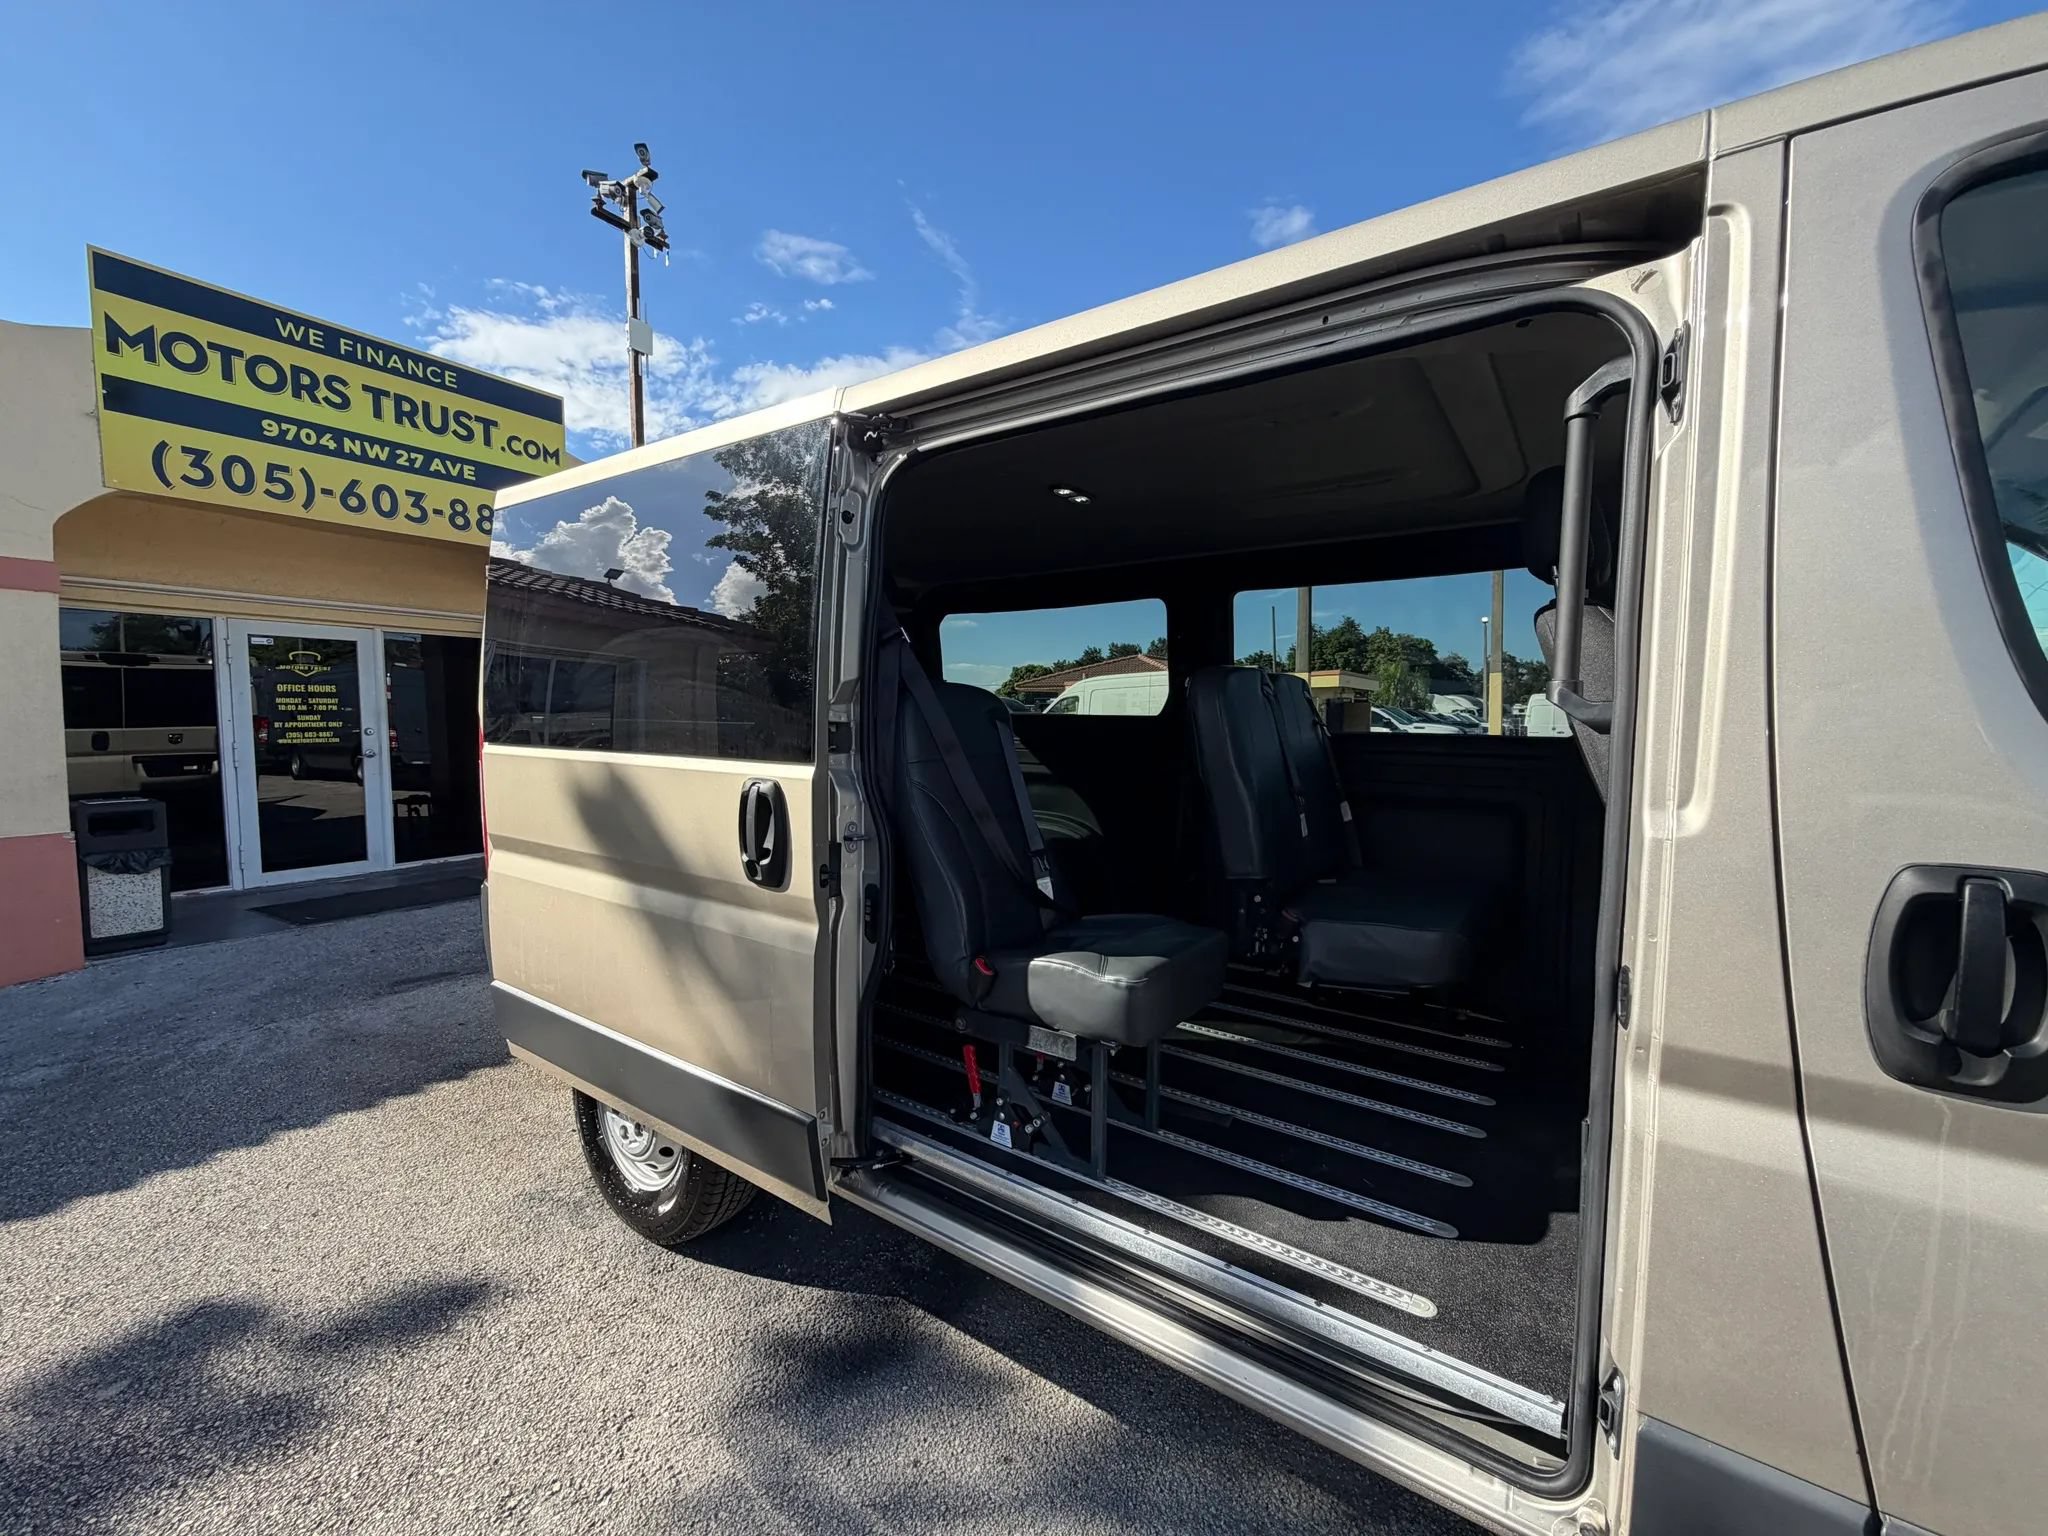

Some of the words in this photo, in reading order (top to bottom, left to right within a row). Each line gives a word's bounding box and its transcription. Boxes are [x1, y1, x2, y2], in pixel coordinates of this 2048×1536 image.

[104, 311, 352, 413] MOTORS
[275, 317, 325, 349] WE
[340, 338, 458, 389] FINANCE
[261, 419, 337, 450] 9704
[343, 438, 392, 463] NW
[395, 449, 424, 468] 27
[428, 457, 476, 481] AVE
[276, 683, 306, 692] OFFICE
[307, 684, 337, 693] HOURS
